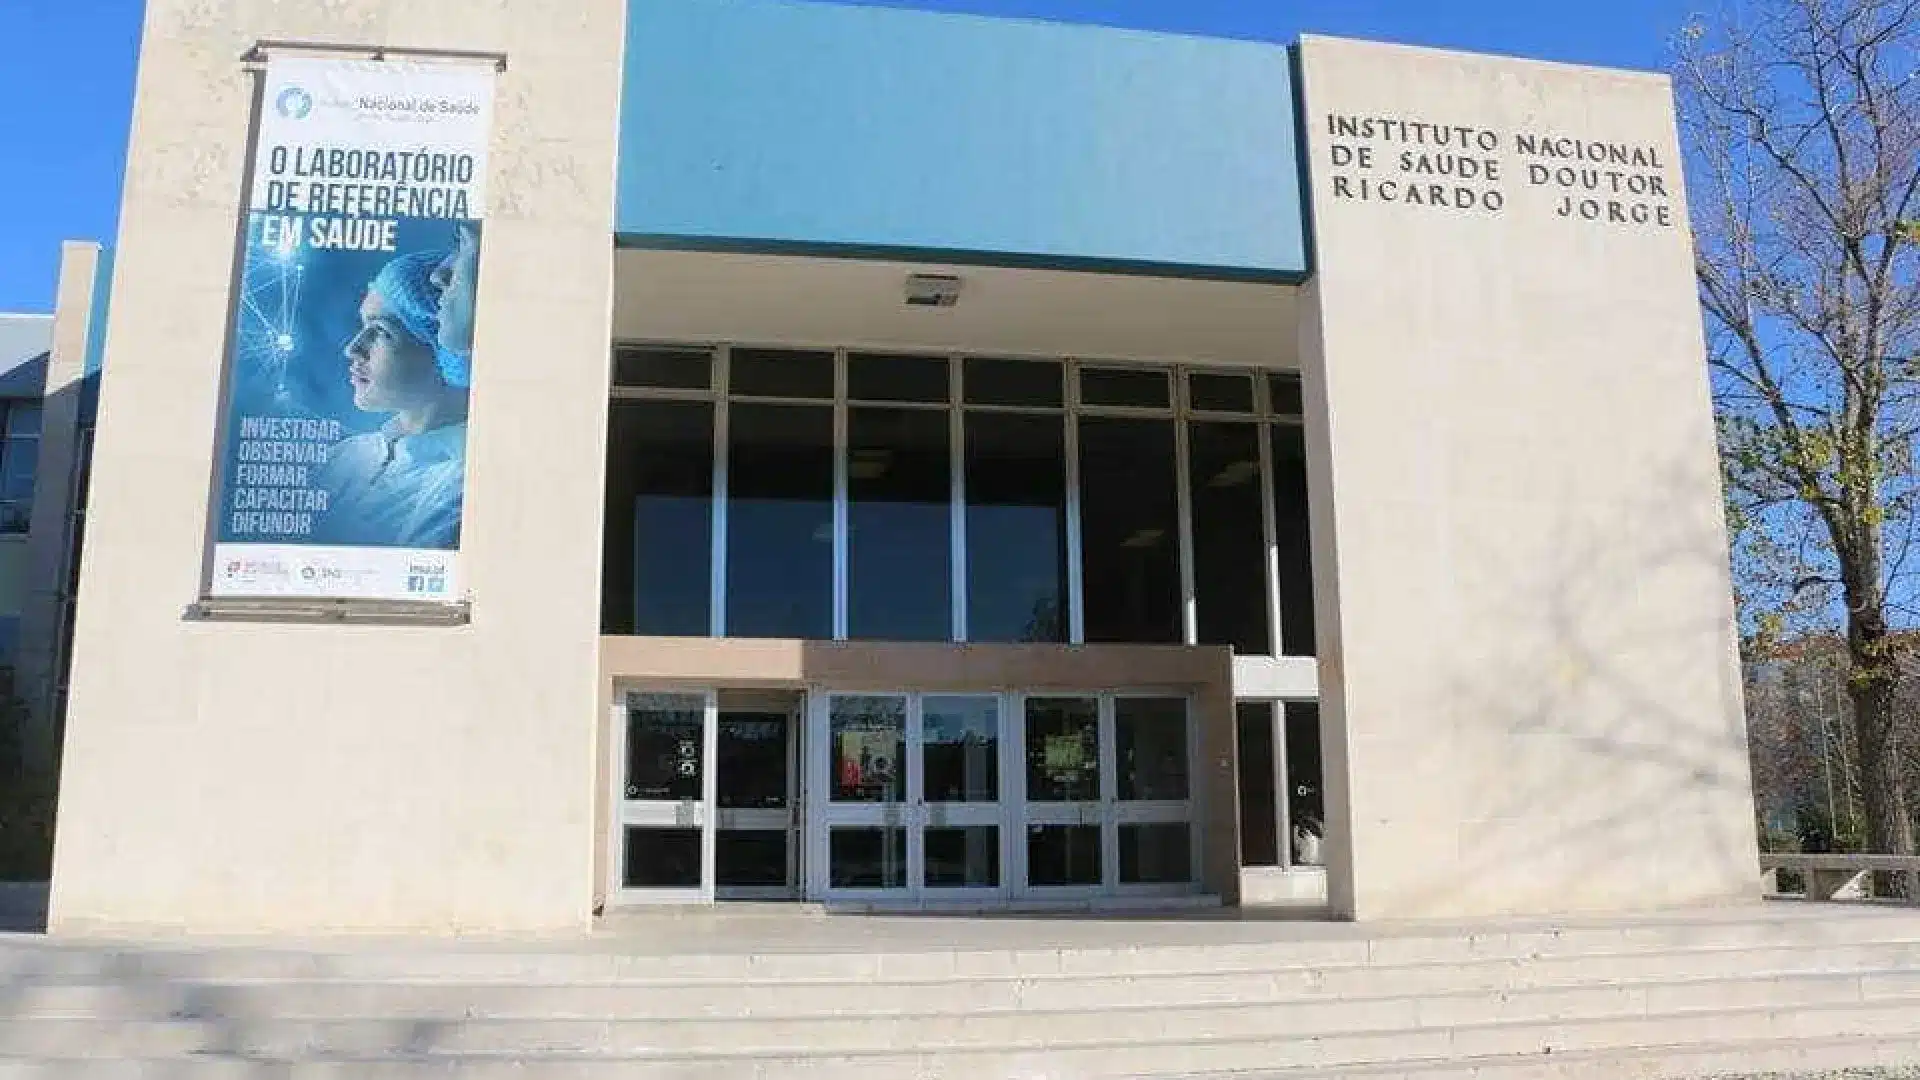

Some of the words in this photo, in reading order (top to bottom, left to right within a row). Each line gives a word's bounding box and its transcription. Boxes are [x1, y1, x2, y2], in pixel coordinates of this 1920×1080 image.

[1327, 114, 1497, 151] INSTITUTO
[1516, 134, 1664, 169] NACIONAL
[270, 146, 287, 175] O
[295, 147, 473, 184] LABORATÓRIO
[1331, 145, 1373, 169] DE
[1399, 151, 1499, 181] SAUDE
[1529, 164, 1668, 197] DOUTOR
[267, 180, 300, 211] DE
[307, 182, 469, 219] REFERÊNCIA
[1333, 176, 1503, 211] RICARDO
[1557, 196, 1672, 226] JORGE
[261, 215, 303, 248] EM
[308, 212, 398, 251] SAÚDE
[241, 417, 341, 440] INVESTIGAR
[239, 441, 327, 463] OBSERVAR
[237, 464, 307, 486] FORMAR
[235, 488, 327, 511] CAPACITAR
[232, 511, 311, 534] DIFUNDIR
